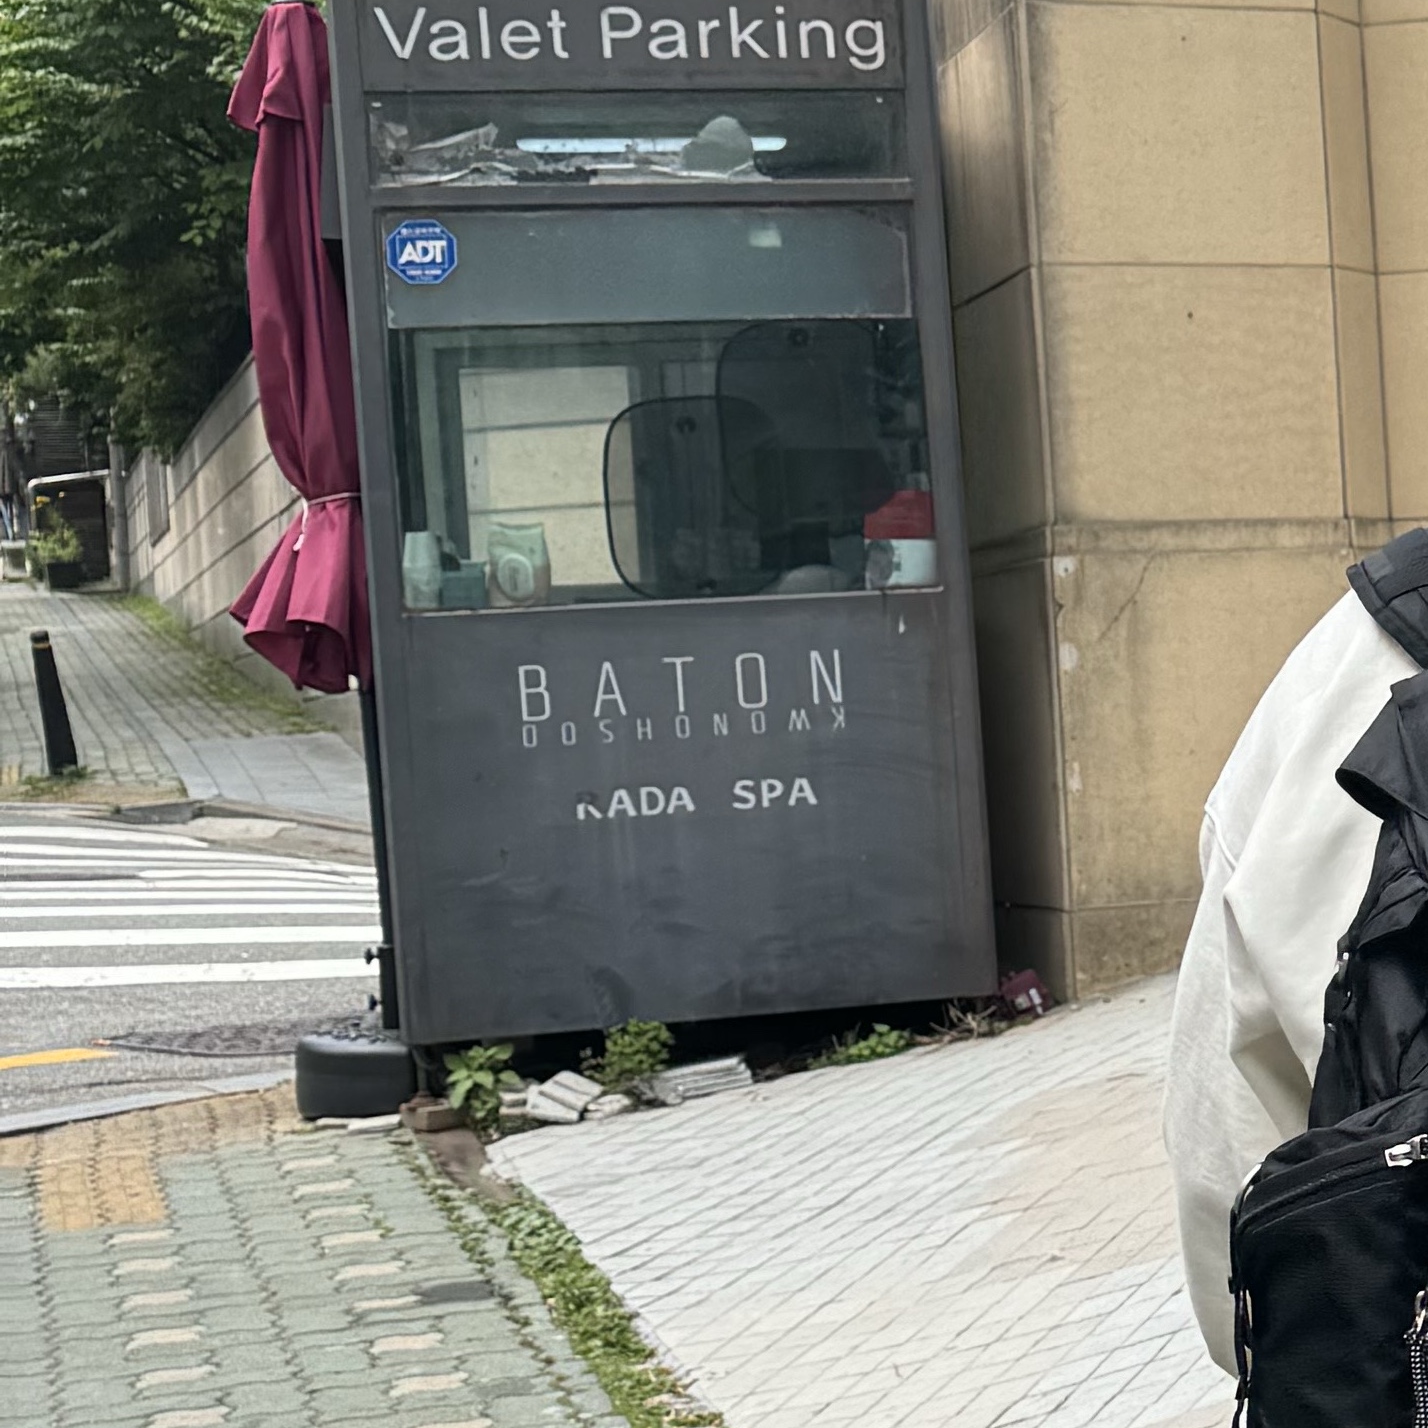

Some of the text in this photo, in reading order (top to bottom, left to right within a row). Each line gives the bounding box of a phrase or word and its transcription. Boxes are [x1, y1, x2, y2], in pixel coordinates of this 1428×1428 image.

[373, 5, 887, 71] Valet Parking
[399, 240, 447, 264] ADT
[518, 649, 844, 722] BATON
[732, 777, 819, 810] SPA
